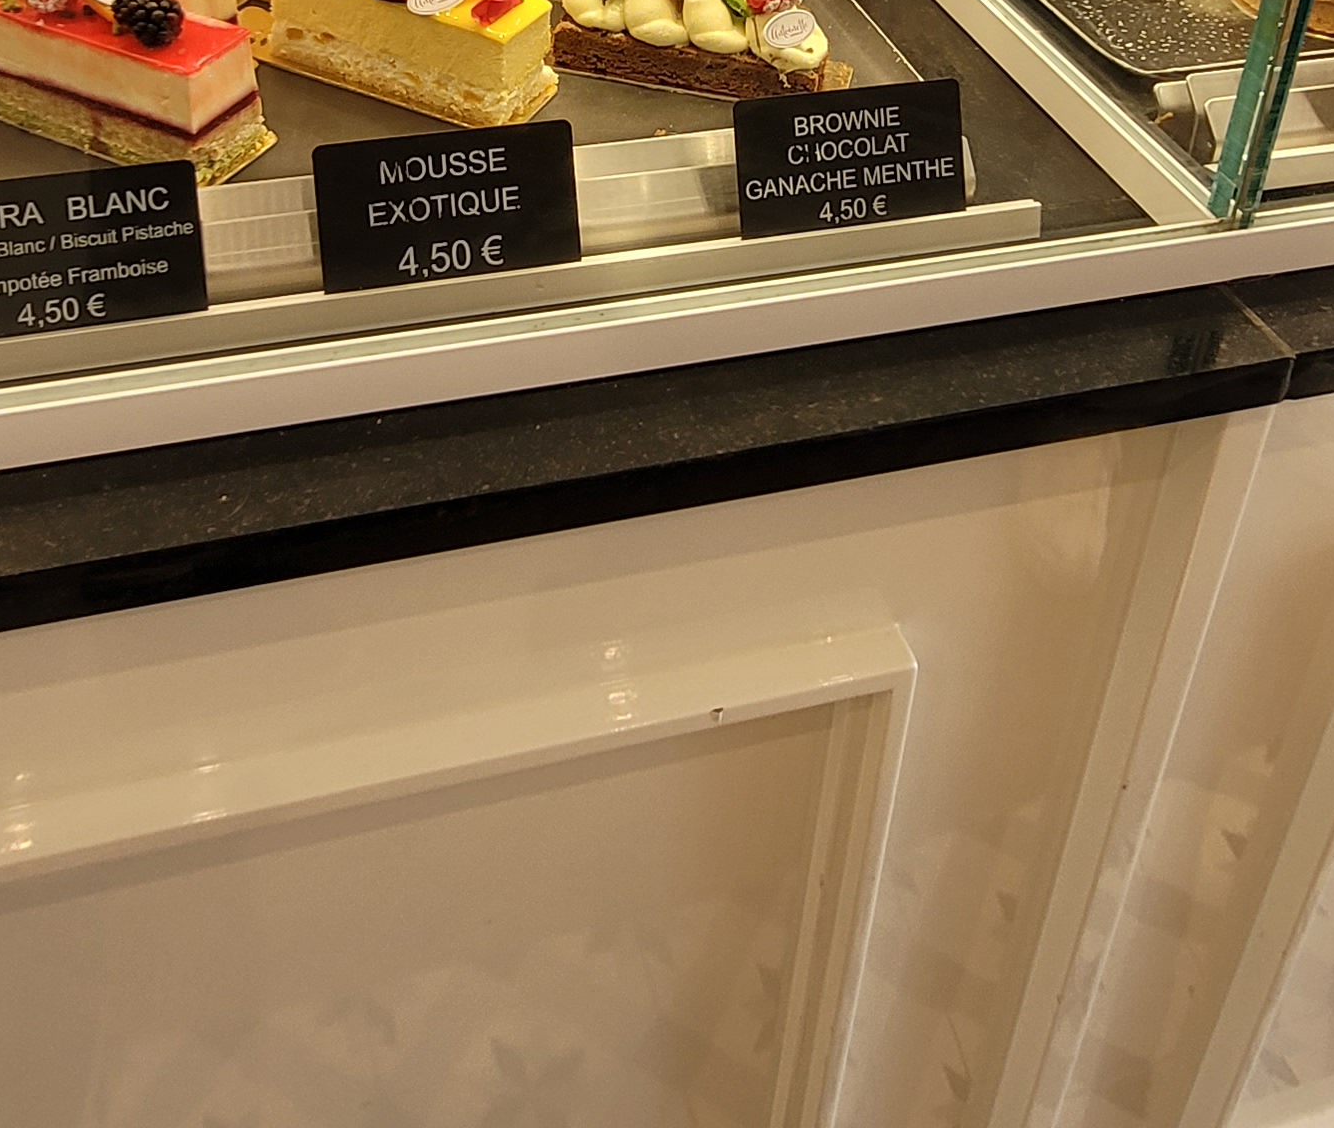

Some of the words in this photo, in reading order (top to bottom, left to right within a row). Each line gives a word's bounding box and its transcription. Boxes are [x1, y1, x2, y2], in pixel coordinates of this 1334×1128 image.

[794, 105, 901, 137] BROWNIE
[379, 147, 508, 186] MOUSSE
[787, 132, 910, 165] CHOCOLAT
[744, 172, 858, 202] GANACHE
[863, 156, 956, 190] MENTHE
[67, 186, 170, 222] BLANC
[368, 185, 522, 228] EXOTIQUE
[819, 197, 867, 225] 4,50
[871, 194, 888, 217] €
[61, 228, 118, 251] Biscuit
[122, 219, 195, 242] Pistache
[68, 257, 170, 285] Framboise
[398, 238, 472, 279] 4,50
[480, 234, 505, 265] €
[17, 297, 80, 329] 4,50
[86, 293, 107, 318] €
